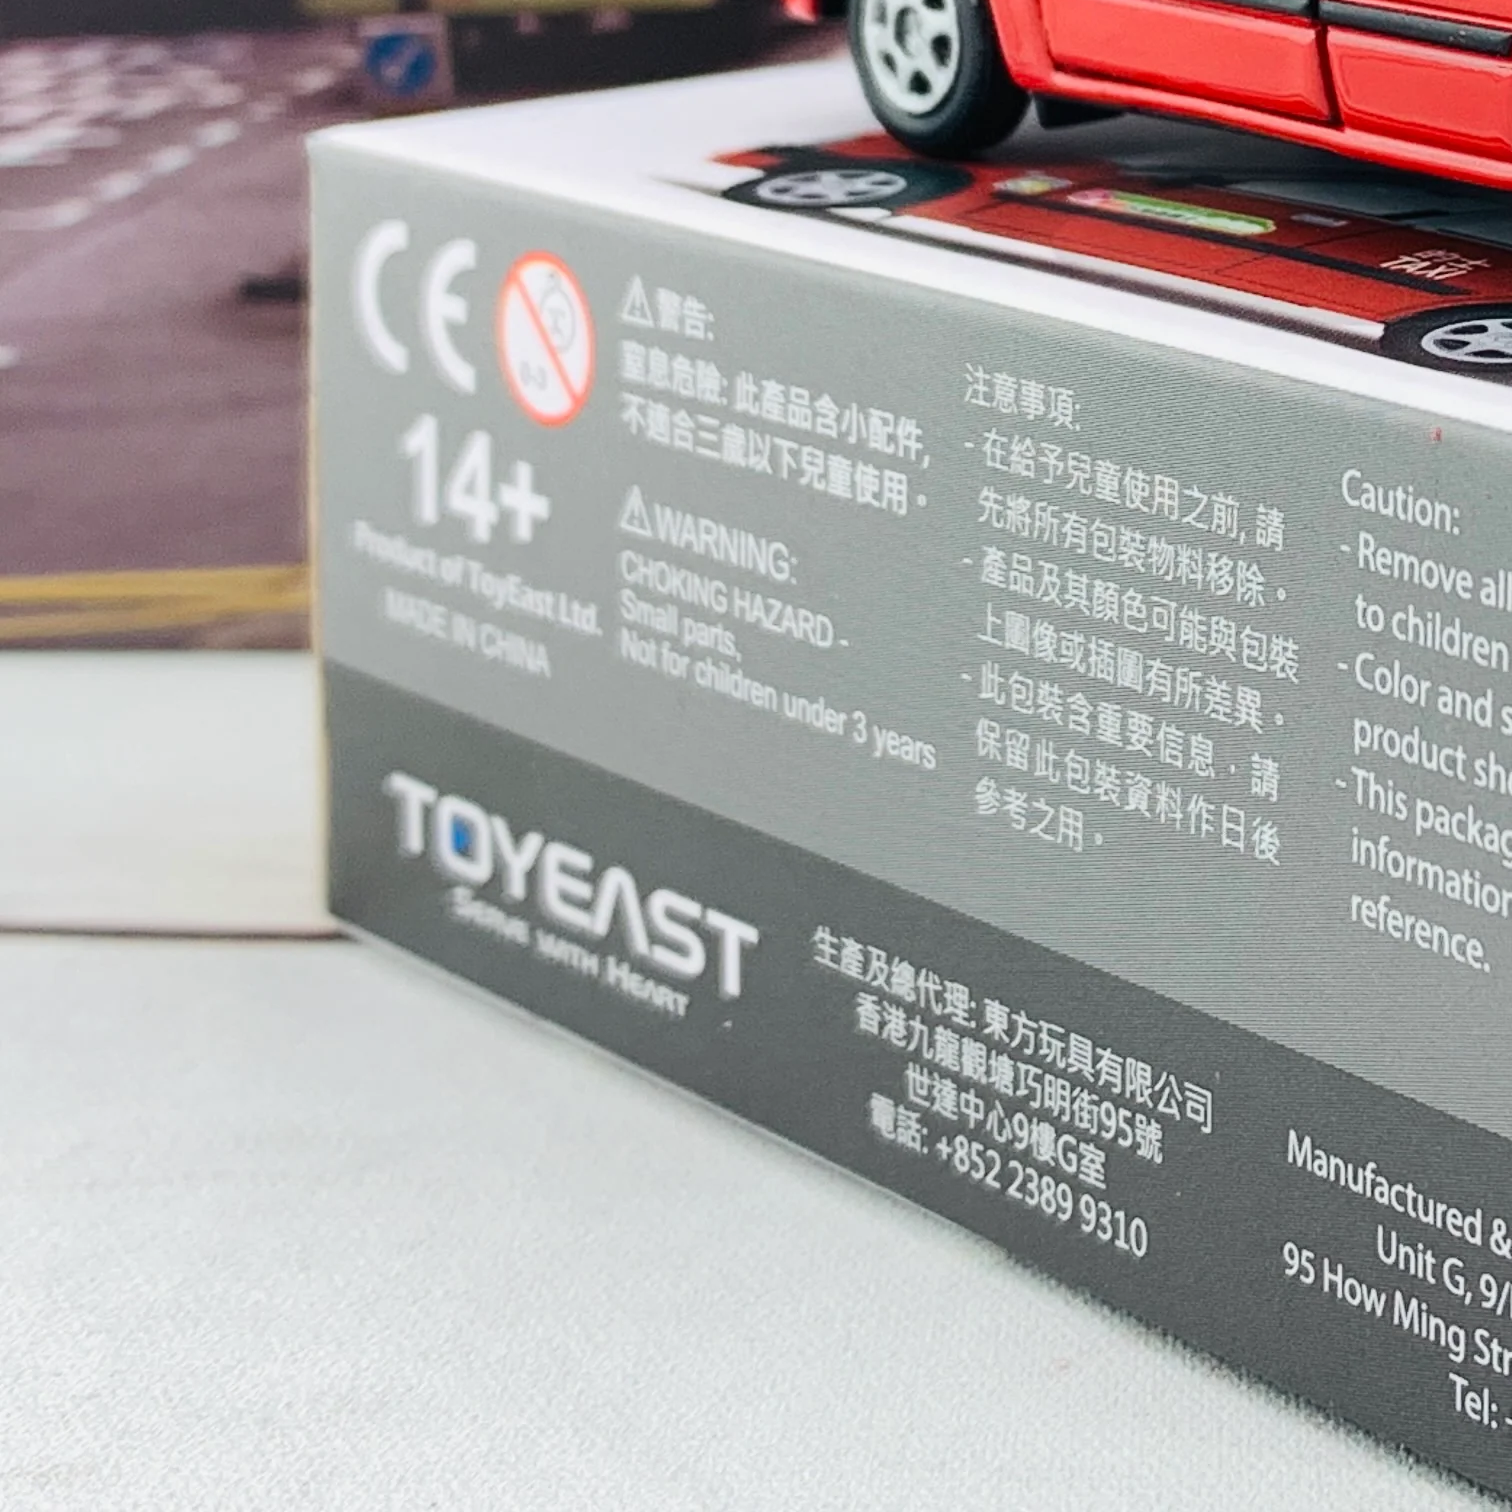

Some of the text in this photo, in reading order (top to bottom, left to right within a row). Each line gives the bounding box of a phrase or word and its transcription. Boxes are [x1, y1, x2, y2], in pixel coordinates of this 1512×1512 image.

[1380, 254, 1468, 281] TAXI
[963, 362, 1081, 431] 注意事項:
[400, 412, 551, 545] 14+
[1341, 468, 1460, 535] Caution:
[653, 503, 798, 585] WARNING:
[1358, 531, 1474, 600] Remove
[620, 549, 730, 615] CHOKING
[733, 587, 834, 648] HAZARD
[620, 588, 679, 635] Small
[1355, 593, 1510, 673] to children
[620, 626, 937, 770] Not for children under 3 years
[1437, 688, 1493, 728] and
[1353, 717, 1467, 782] product
[384, 770, 760, 999] TOYEAST
[1350, 893, 1491, 974] reference.
[936, 1134, 1001, 1188] +852
[1007, 1159, 1074, 1222] 2389
[1079, 1192, 1149, 1258] 9310
[1286, 1128, 1483, 1246] Manufactured
[1489, 1217, 1512, 1259] &
[1282, 1241, 1316, 1285] 95
[1323, 1257, 1387, 1317] How
[1393, 1290, 1467, 1363] Ming
[1377, 1224, 1437, 1284] Unit
[1443, 1257, 1473, 1306] G,
[1449, 1372, 1498, 1430] Tel:
